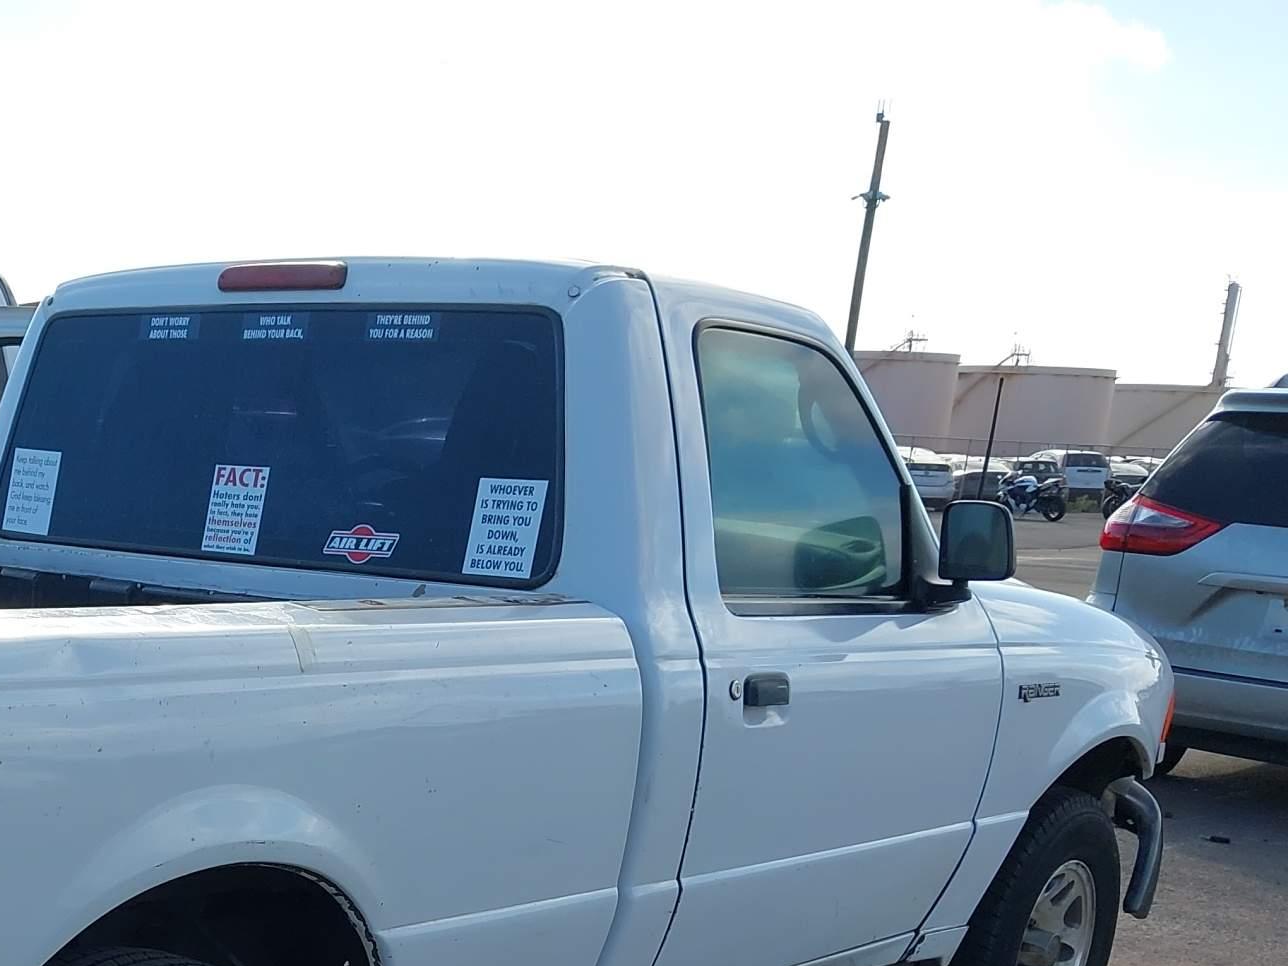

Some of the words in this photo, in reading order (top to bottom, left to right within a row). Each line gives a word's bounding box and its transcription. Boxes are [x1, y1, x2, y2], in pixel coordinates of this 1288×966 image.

[170, 317, 190, 326] WORRY
[260, 316, 275, 325] WHO
[276, 315, 291, 325] TALK
[376, 315, 402, 325] THEY'RE
[403, 315, 431, 325] BEHIND
[149, 329, 169, 339] ABOUT
[170, 329, 188, 339] THOSE
[243, 329, 266, 339] BEHIND
[267, 329, 285, 339] YOUR
[369, 329, 384, 339] YOU
[385, 329, 399, 339] FOR
[399, 329, 405, 339] A
[406, 328, 434, 339] REASON
[215, 466, 266, 488] FACT:
[213, 490, 240, 500] Haters
[243, 492, 263, 502] dont
[490, 484, 534, 496] WHOEVER
[211, 501, 229, 509] really
[230, 501, 245, 509] hate
[481, 499, 488, 509] IS
[491, 499, 523, 511] TRYING
[526, 501, 538, 511] TO
[208, 516, 256, 529] themselves
[481, 514, 509, 525] BRING
[512, 516, 531, 527] YOU
[207, 526, 230, 534] because
[487, 529, 519, 542] DOWN,
[205, 533, 241, 544] reflection
[243, 535, 252, 545] of
[328, 537, 357, 550] AIR
[359, 539, 394, 552] LIFT
[476, 544, 484, 554] IS
[486, 544, 525, 557] ALREADY
[470, 558, 502, 570] BELOW
[504, 561, 524, 572] YOU.
